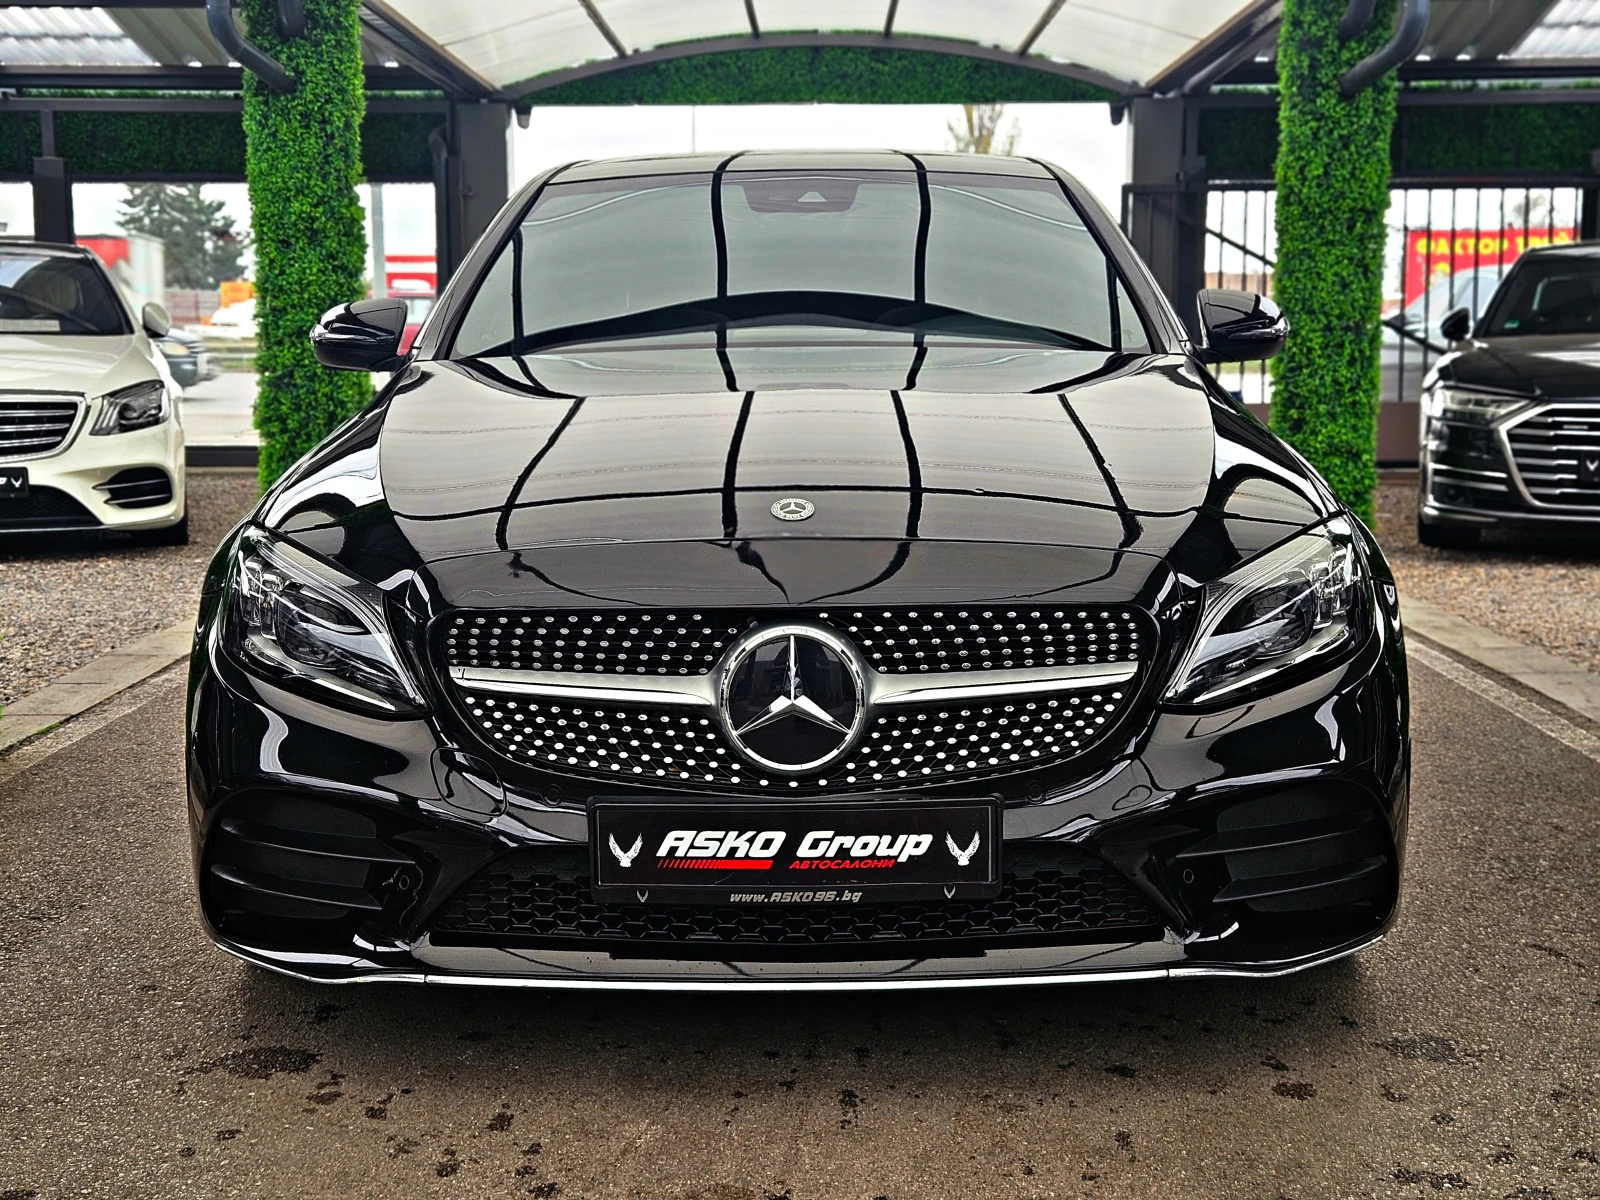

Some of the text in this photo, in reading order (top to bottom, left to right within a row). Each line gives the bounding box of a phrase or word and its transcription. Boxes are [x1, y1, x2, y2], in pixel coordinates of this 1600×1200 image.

[1415, 237, 1508, 255] ФАКТОР
[656, 830, 934, 862] ASKO Group
[788, 859, 896, 870] АВТОСАЛОНИ
[729, 890, 862, 903] www.ASKO96.bg
